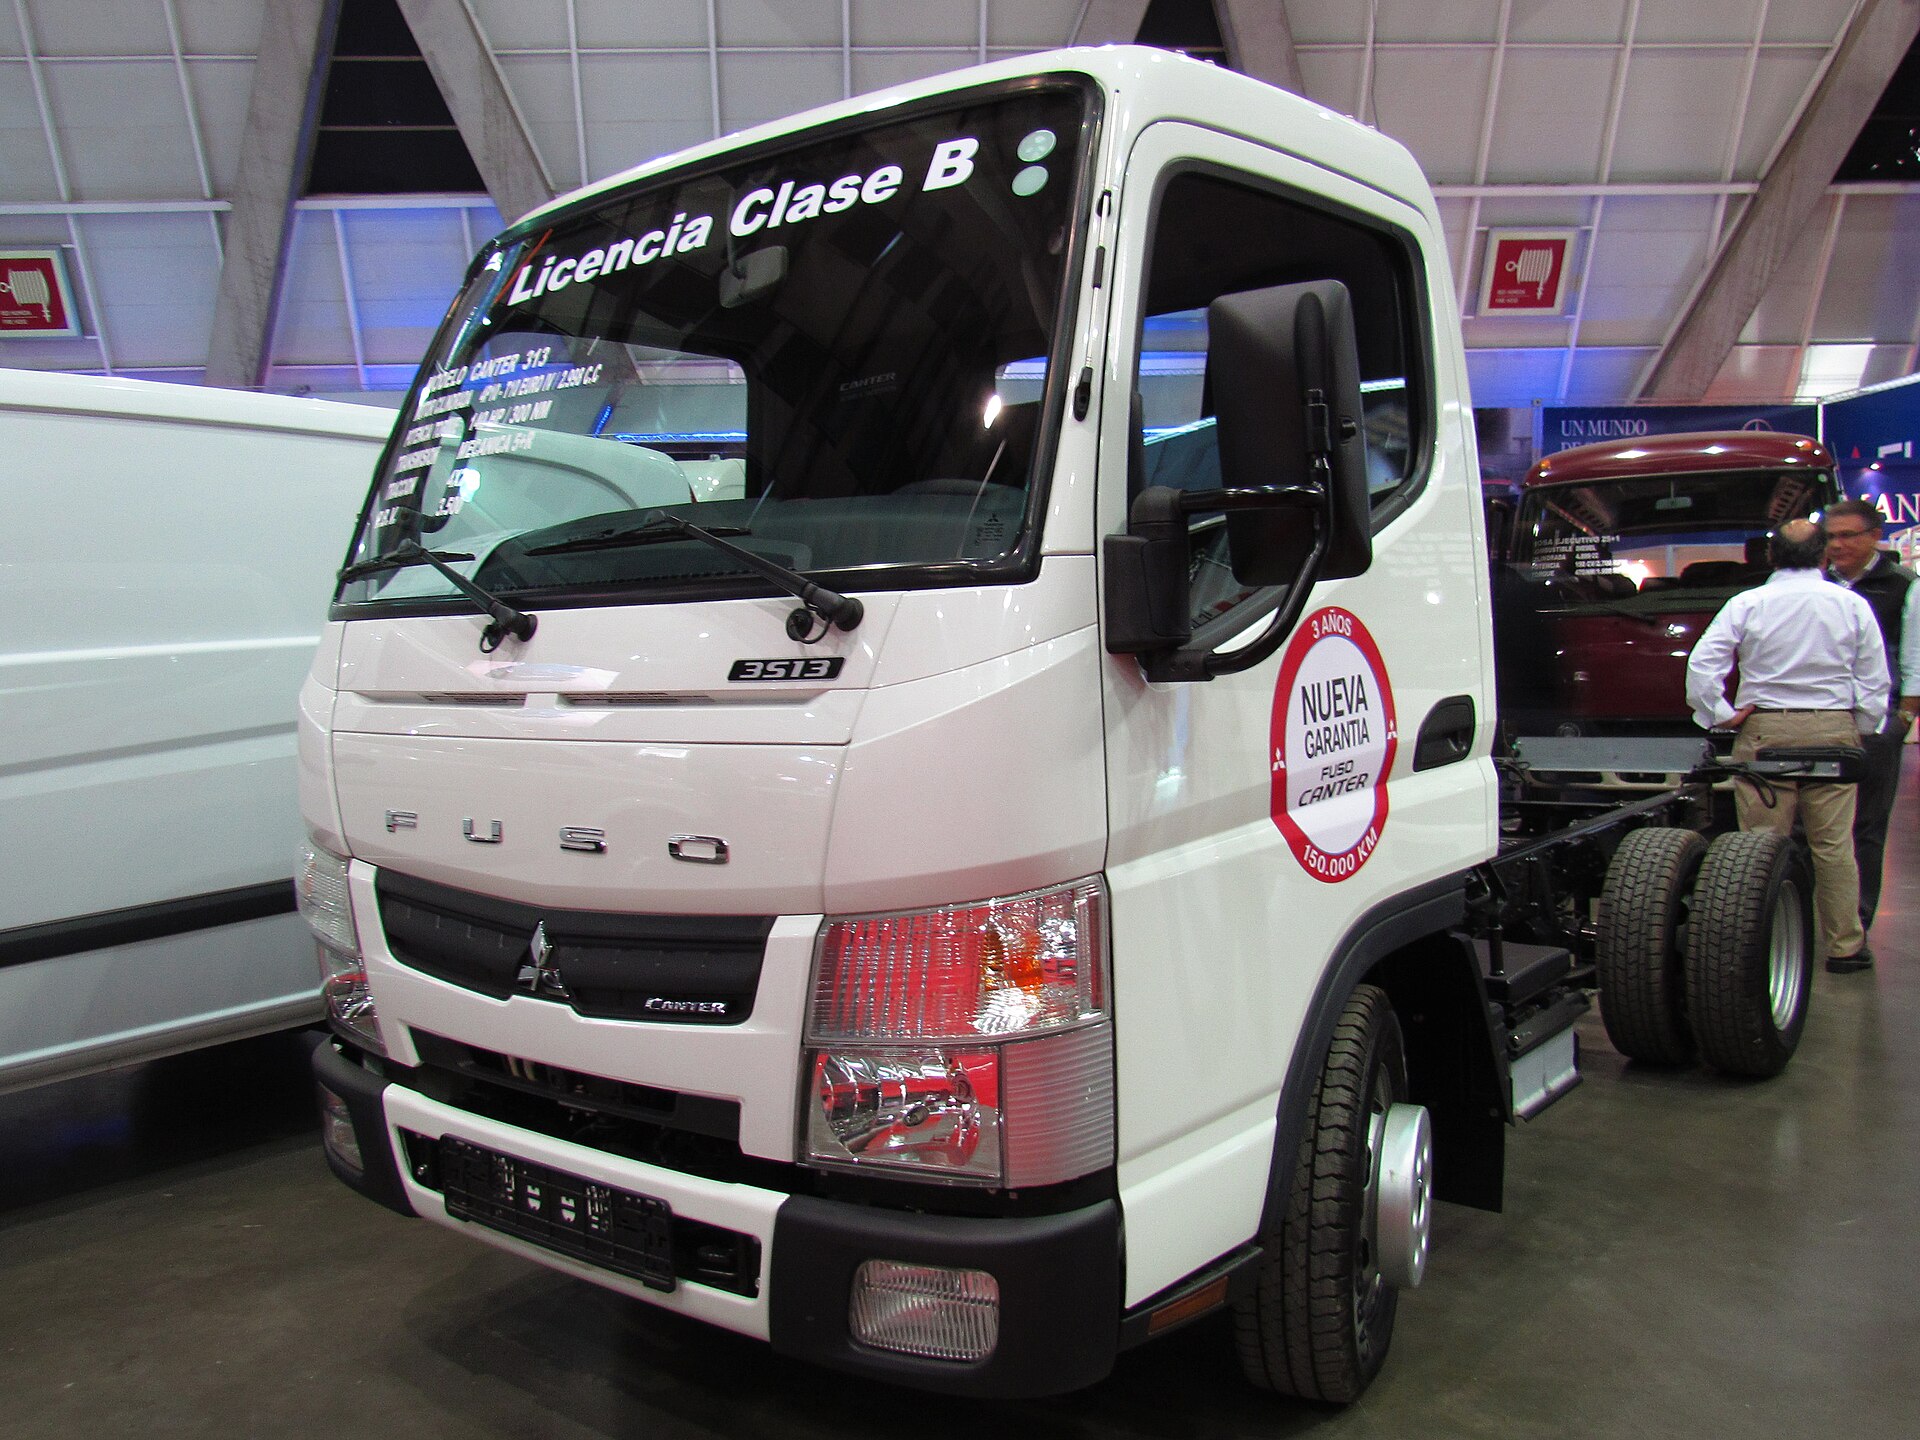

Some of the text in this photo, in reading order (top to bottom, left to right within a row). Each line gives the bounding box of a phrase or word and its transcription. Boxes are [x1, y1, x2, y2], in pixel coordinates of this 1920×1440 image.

[508, 137, 980, 306] Licencia Clase B
[470, 354, 520, 381] CANTER
[1561, 419, 1647, 436] UN MUNDO
[1312, 610, 1352, 639] 3 AÑOS
[1301, 673, 1368, 726] NUEVA
[1304, 717, 1370, 759] GARANTIA
[1299, 773, 1369, 807] CANTER
[1320, 760, 1354, 782] FUSO
[385, 808, 730, 864] FUSO
[1303, 833, 1378, 877] 150.000 KM
